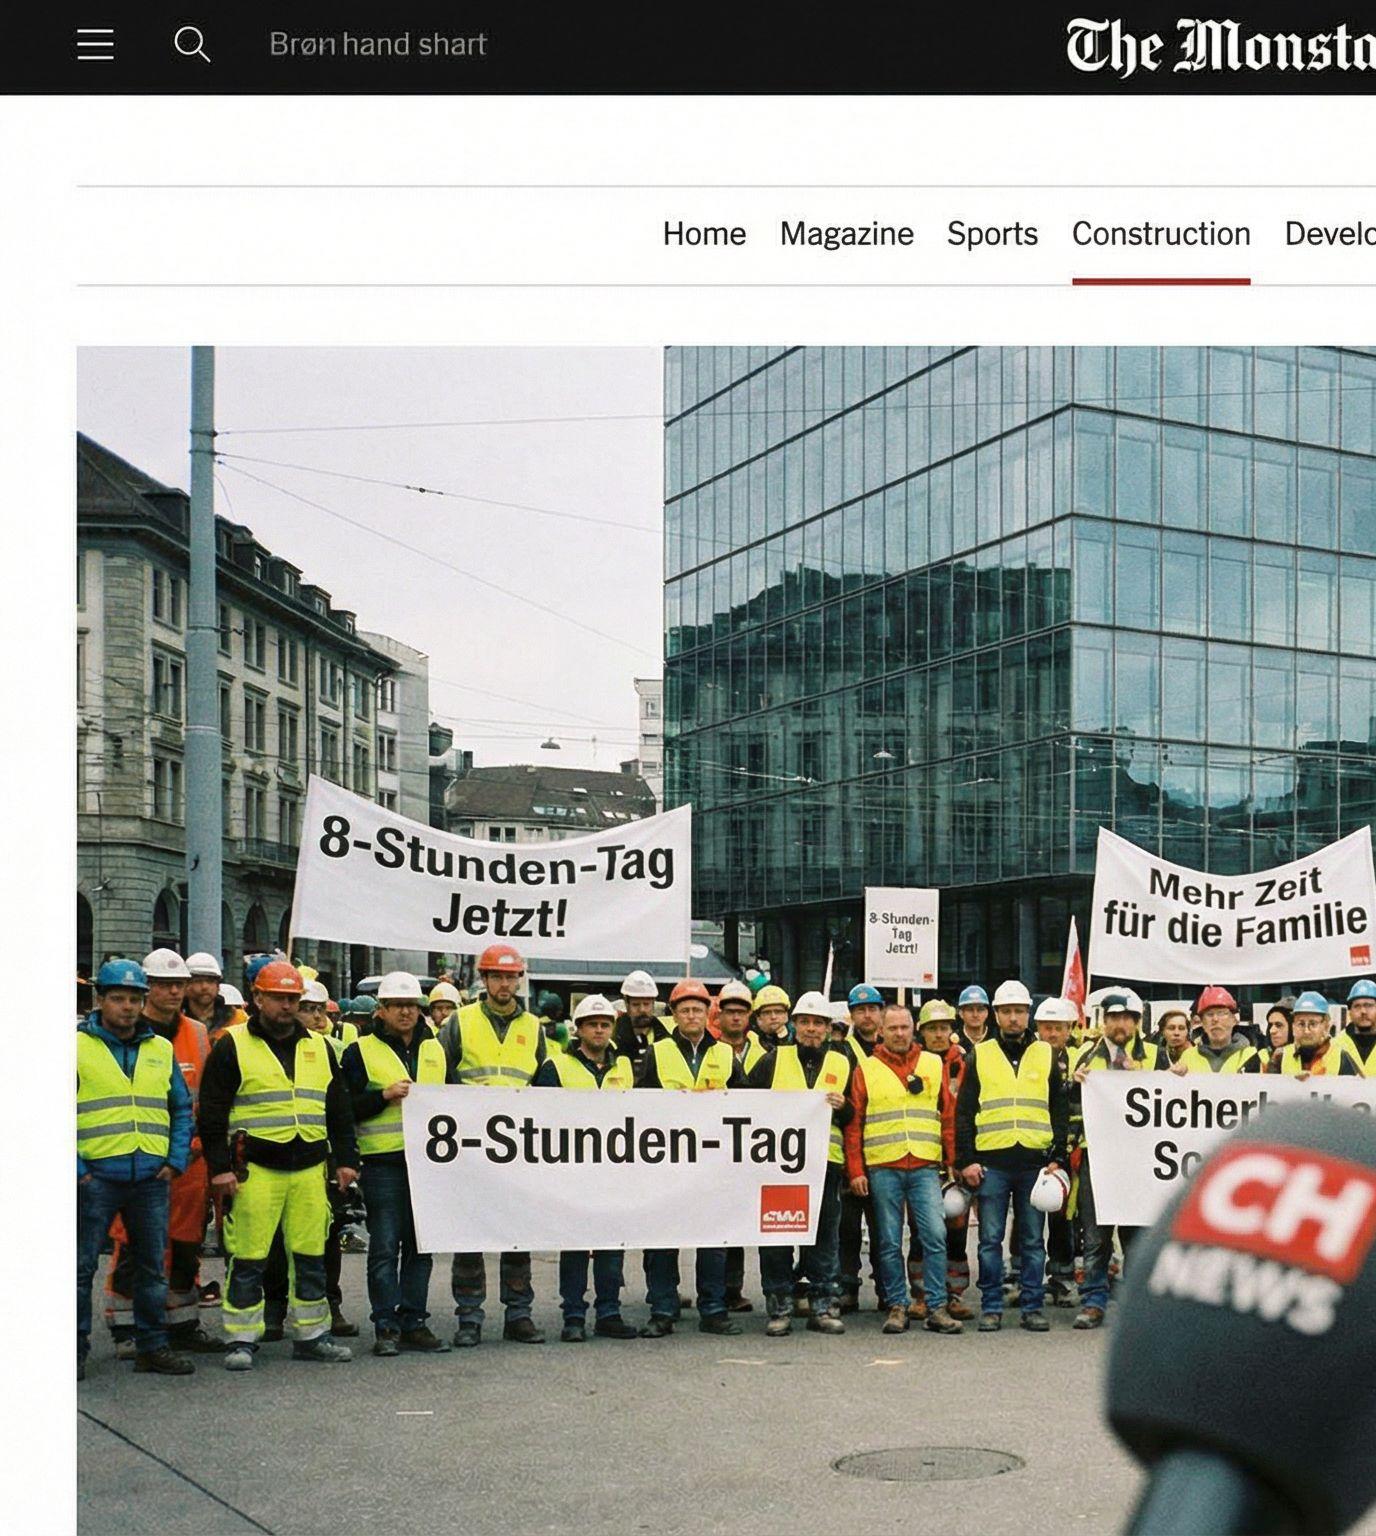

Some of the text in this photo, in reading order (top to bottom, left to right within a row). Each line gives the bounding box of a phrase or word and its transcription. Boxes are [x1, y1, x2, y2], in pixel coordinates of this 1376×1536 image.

[319, 815, 675, 890] 8-Stunden-Tag
[432, 892, 568, 938] Jetzt!
[1149, 866, 1324, 911] Mehr Zeit
[891, 927, 912, 942] Tag
[1103, 899, 1368, 949] für die Familie
[425, 1114, 807, 1174] 8-Stunden-Tag
[1199, 1152, 1376, 1265] CH
[1148, 1240, 1344, 1337] NEWS
